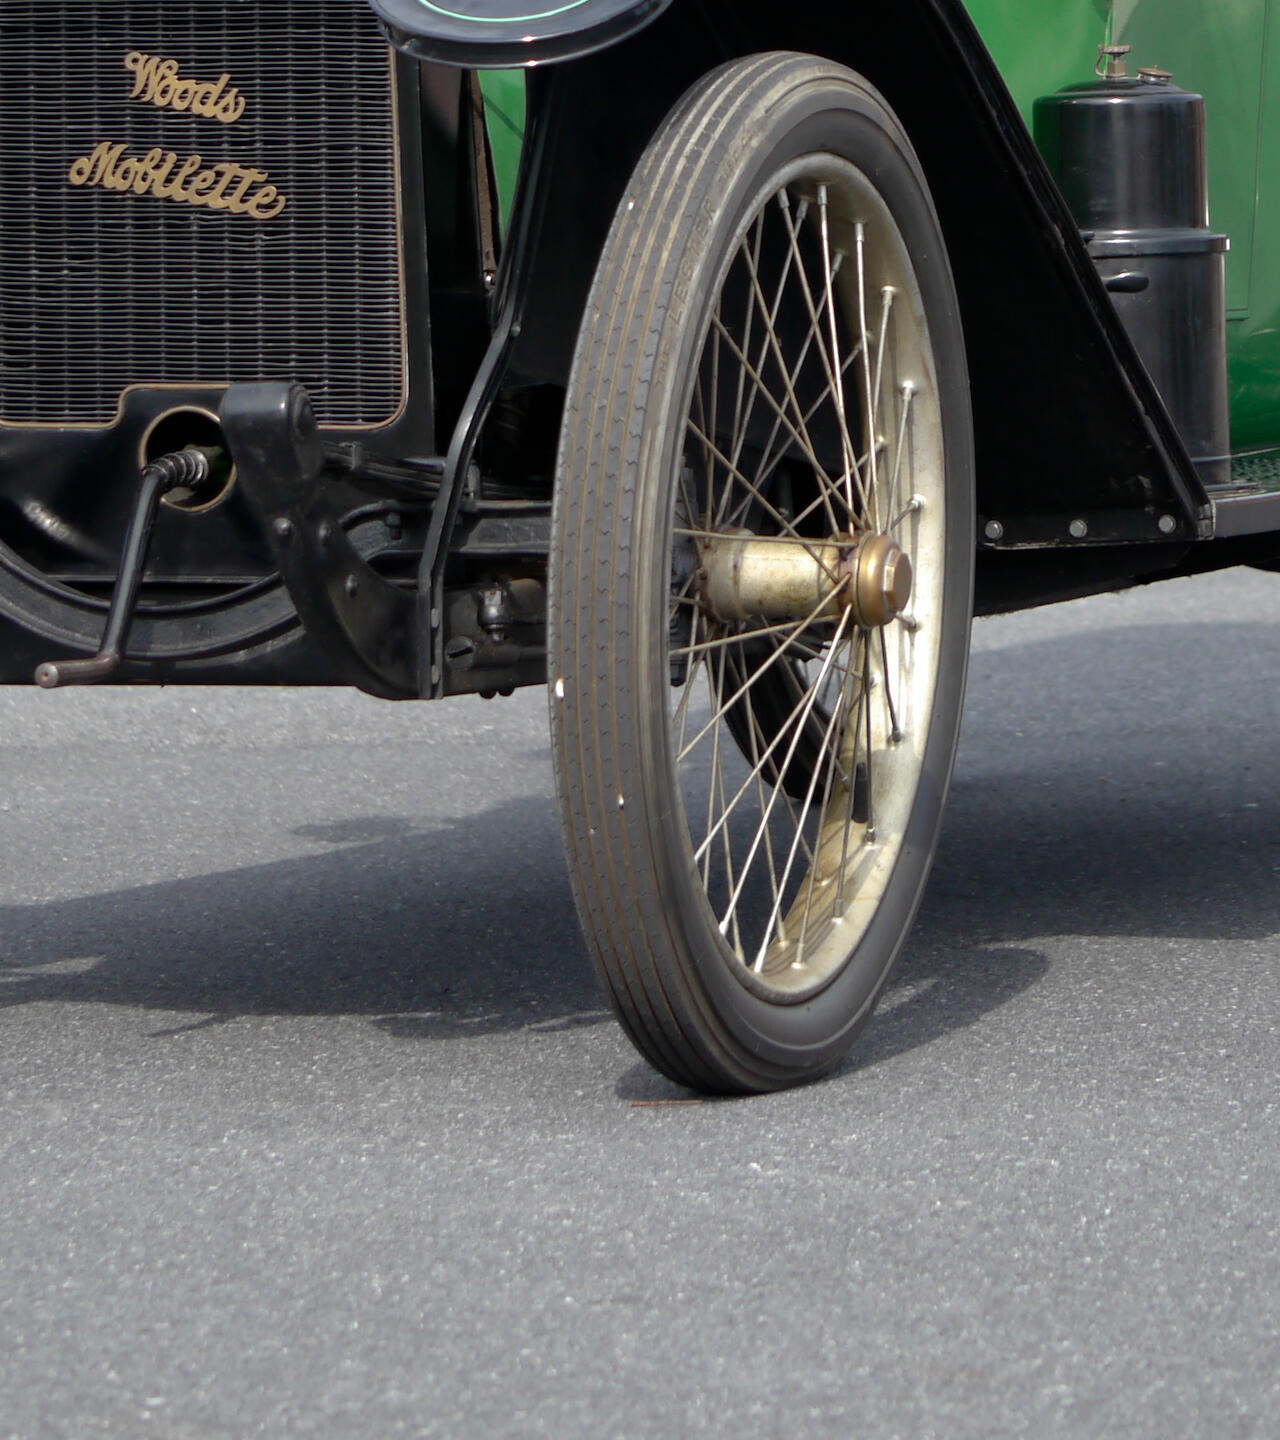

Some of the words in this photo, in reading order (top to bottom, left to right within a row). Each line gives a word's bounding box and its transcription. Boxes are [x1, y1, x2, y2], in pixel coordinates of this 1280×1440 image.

[124, 51, 246, 123] Woods
[69, 141, 286, 219] Mobilette
[667, 194, 717, 327] LESTER
